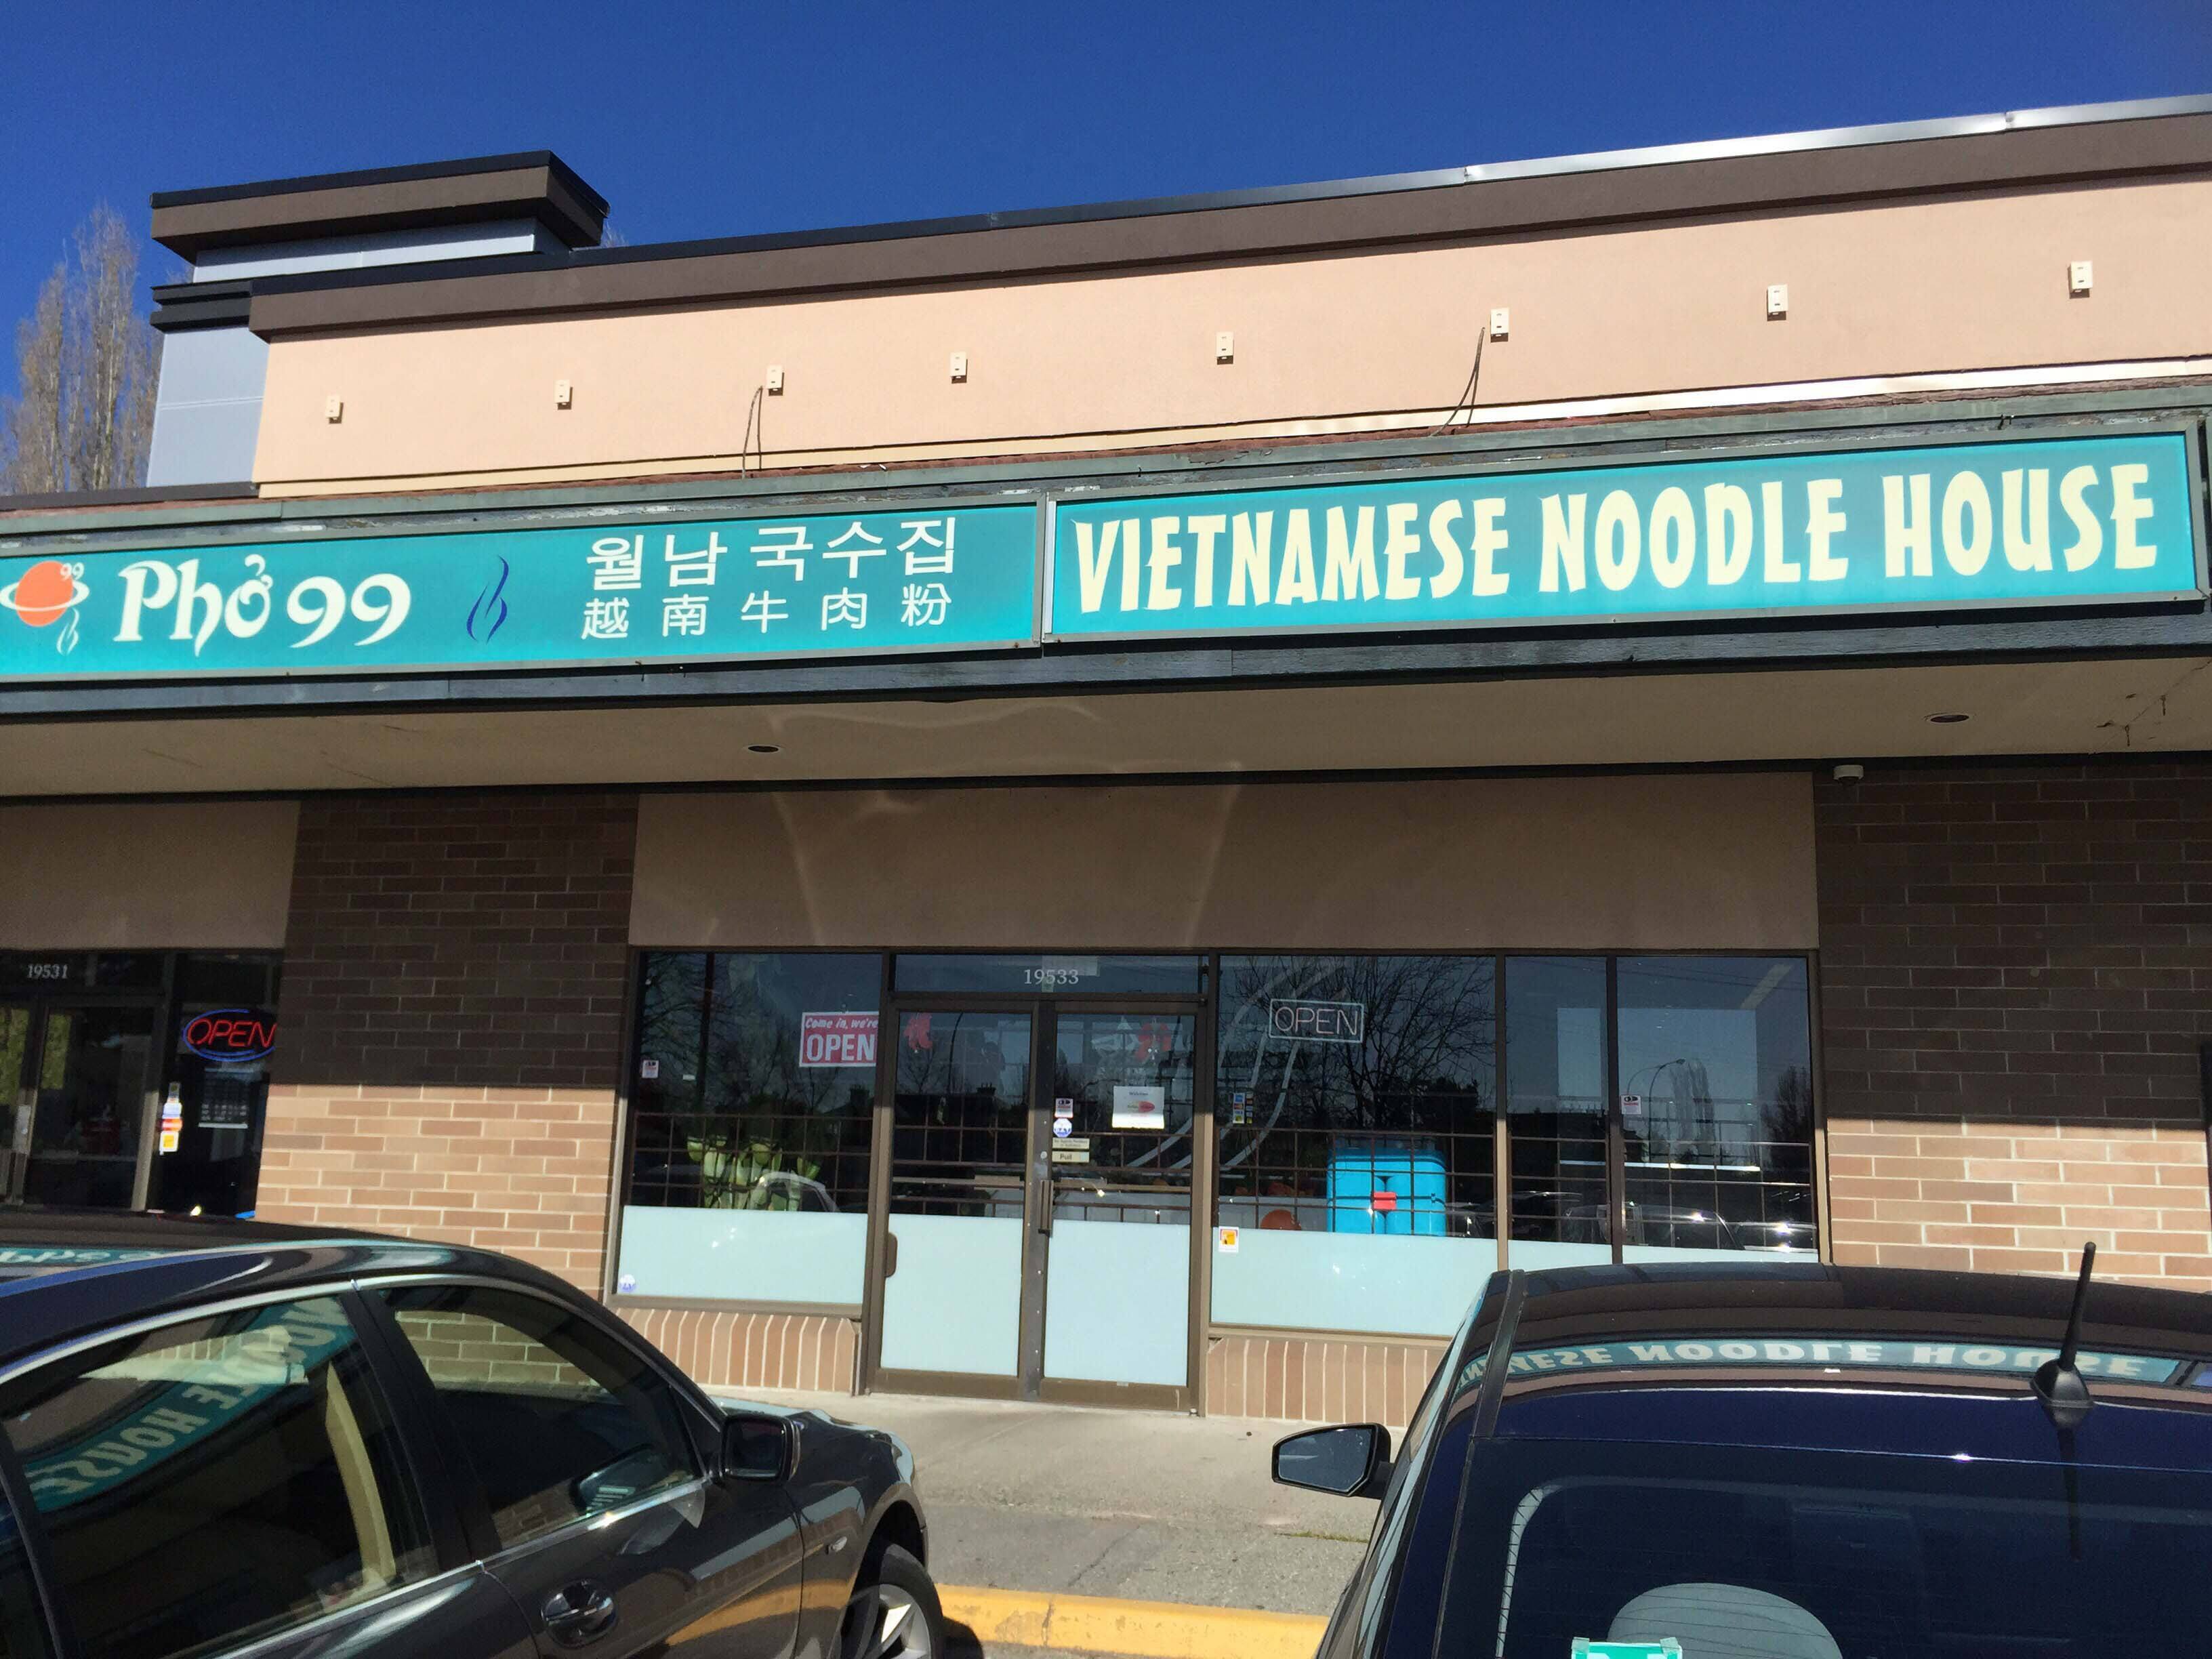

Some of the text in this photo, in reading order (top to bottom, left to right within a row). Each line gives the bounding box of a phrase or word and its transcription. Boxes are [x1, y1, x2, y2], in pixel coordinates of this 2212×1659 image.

[1070, 464, 2158, 614] VIETNAMESE NOODLE HOUSE
[60, 562, 84, 580] 99
[113, 554, 411, 657] Phở 99
[581, 583, 952, 640] 越南牛肉粉
[27, 964, 68, 979] 19531
[1024, 969, 1079, 985] 19533
[187, 1018, 277, 1048] OPEN
[805, 1018, 833, 1029] Come
[1275, 1006, 1358, 1036] OPEN
[806, 1034, 876, 1062] OPEN
